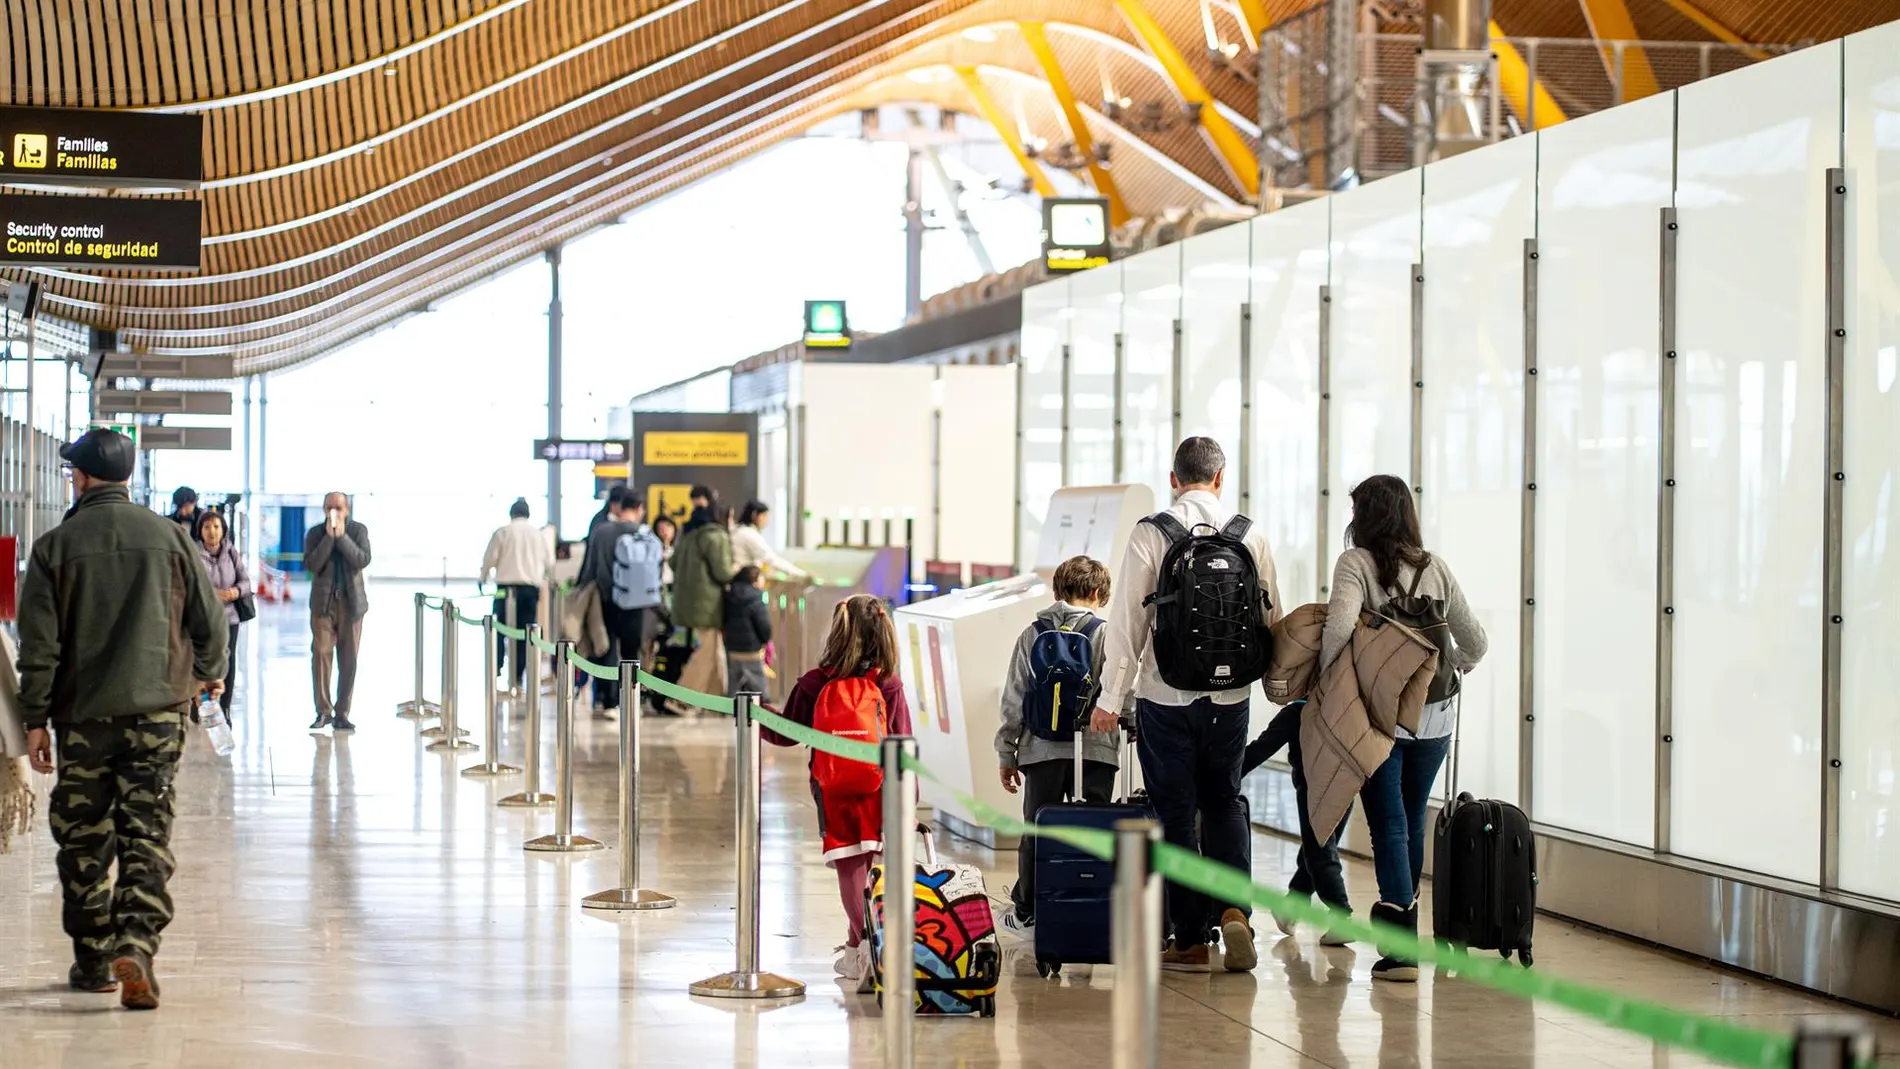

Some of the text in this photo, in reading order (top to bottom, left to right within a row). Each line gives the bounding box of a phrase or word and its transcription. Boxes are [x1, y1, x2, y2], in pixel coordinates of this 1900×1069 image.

[57, 136, 108, 152] Families
[57, 152, 117, 170] Familias
[7, 221, 104, 239] Security control
[7, 237, 158, 259] Control de seguridad
